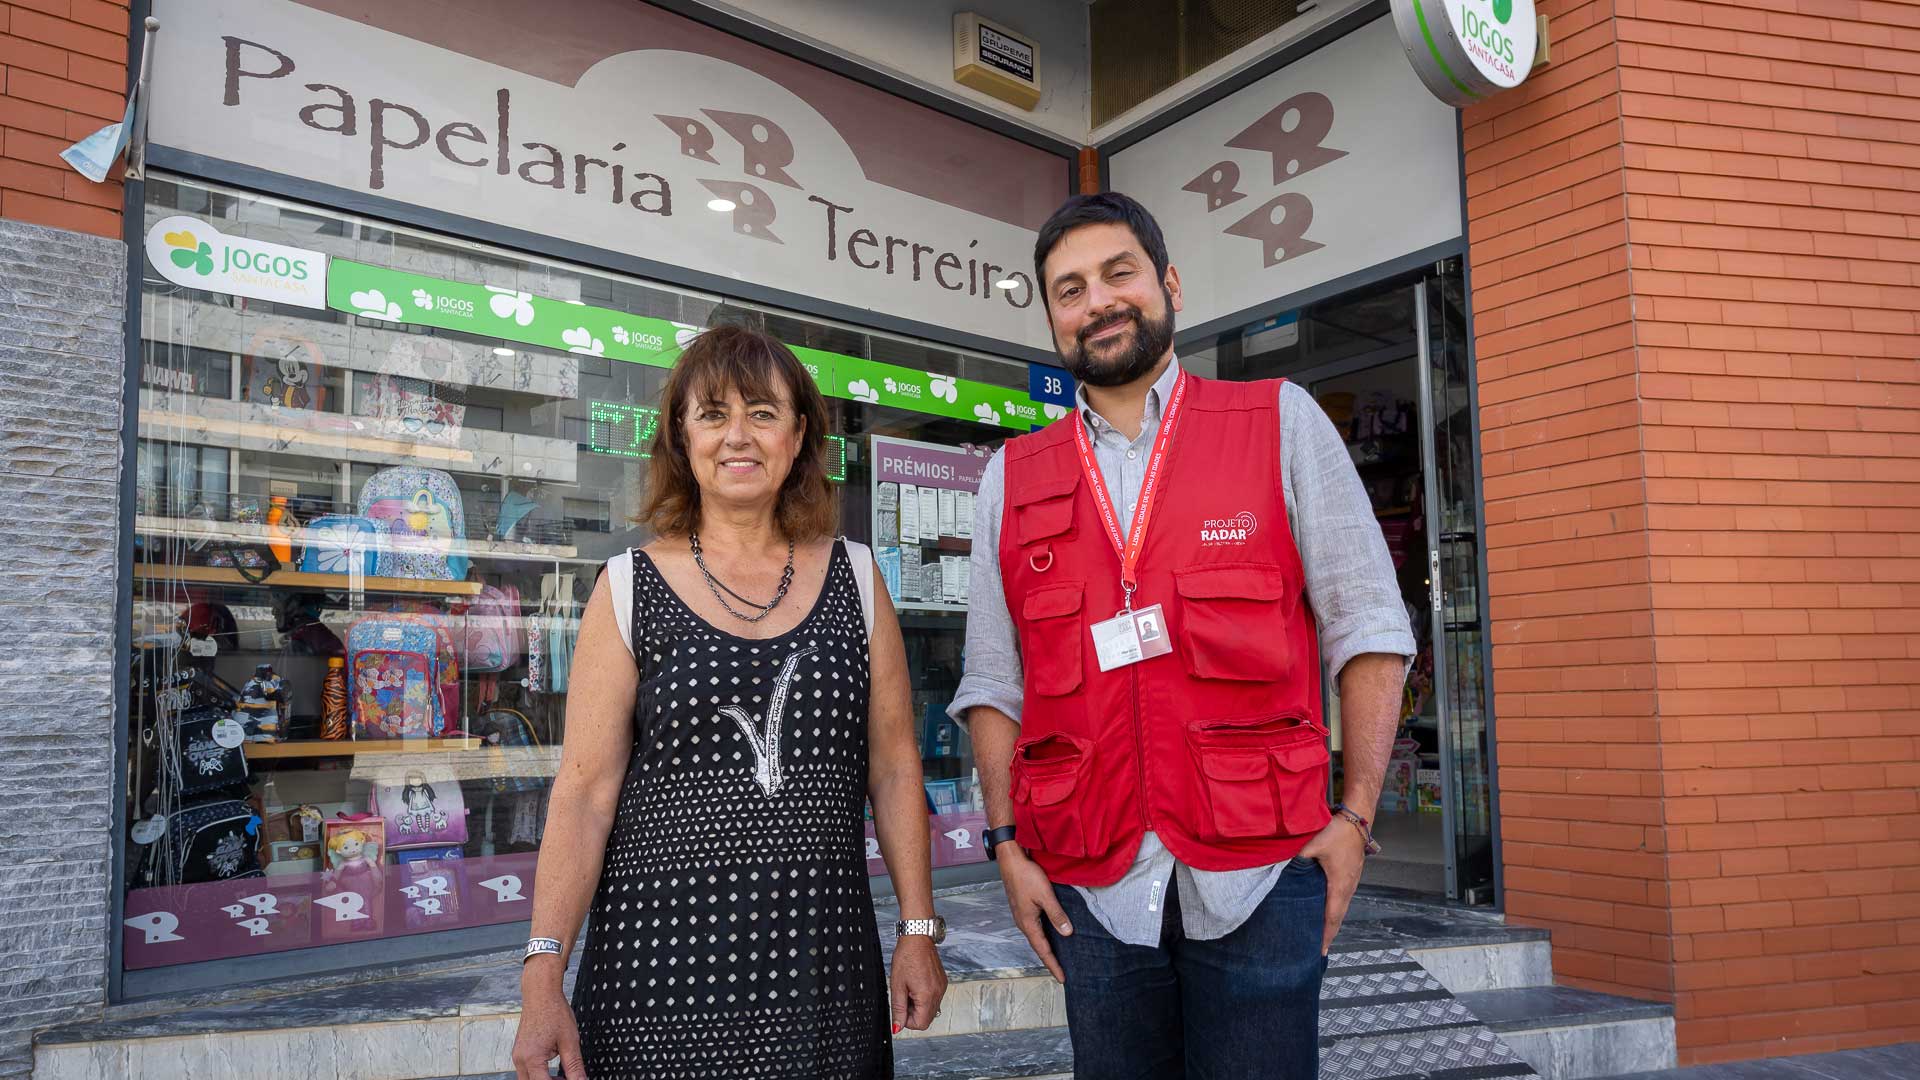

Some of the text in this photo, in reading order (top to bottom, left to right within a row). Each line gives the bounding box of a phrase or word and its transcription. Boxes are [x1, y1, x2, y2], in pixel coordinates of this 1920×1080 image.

[1461, 4, 1514, 64] JOGOS
[982, 36, 1031, 61] GRUPEME
[981, 49, 1032, 76] SEGURANÇA
[1468, 39, 1516, 81] SANTACASA
[222, 246, 308, 281] JOGOS
[436, 295, 474, 313] JOGOS
[631, 331, 663, 347] JOGOS
[143, 363, 194, 393] MARVEL
[898, 381, 921, 394] JOGOS
[1044, 375, 1063, 395] 3B
[1016, 404, 1037, 416] JOGOS
[883, 456, 956, 481] PRÉMIOS!
[1204, 518, 1250, 528] PROJETO
[1200, 529, 1247, 541] RADAR
